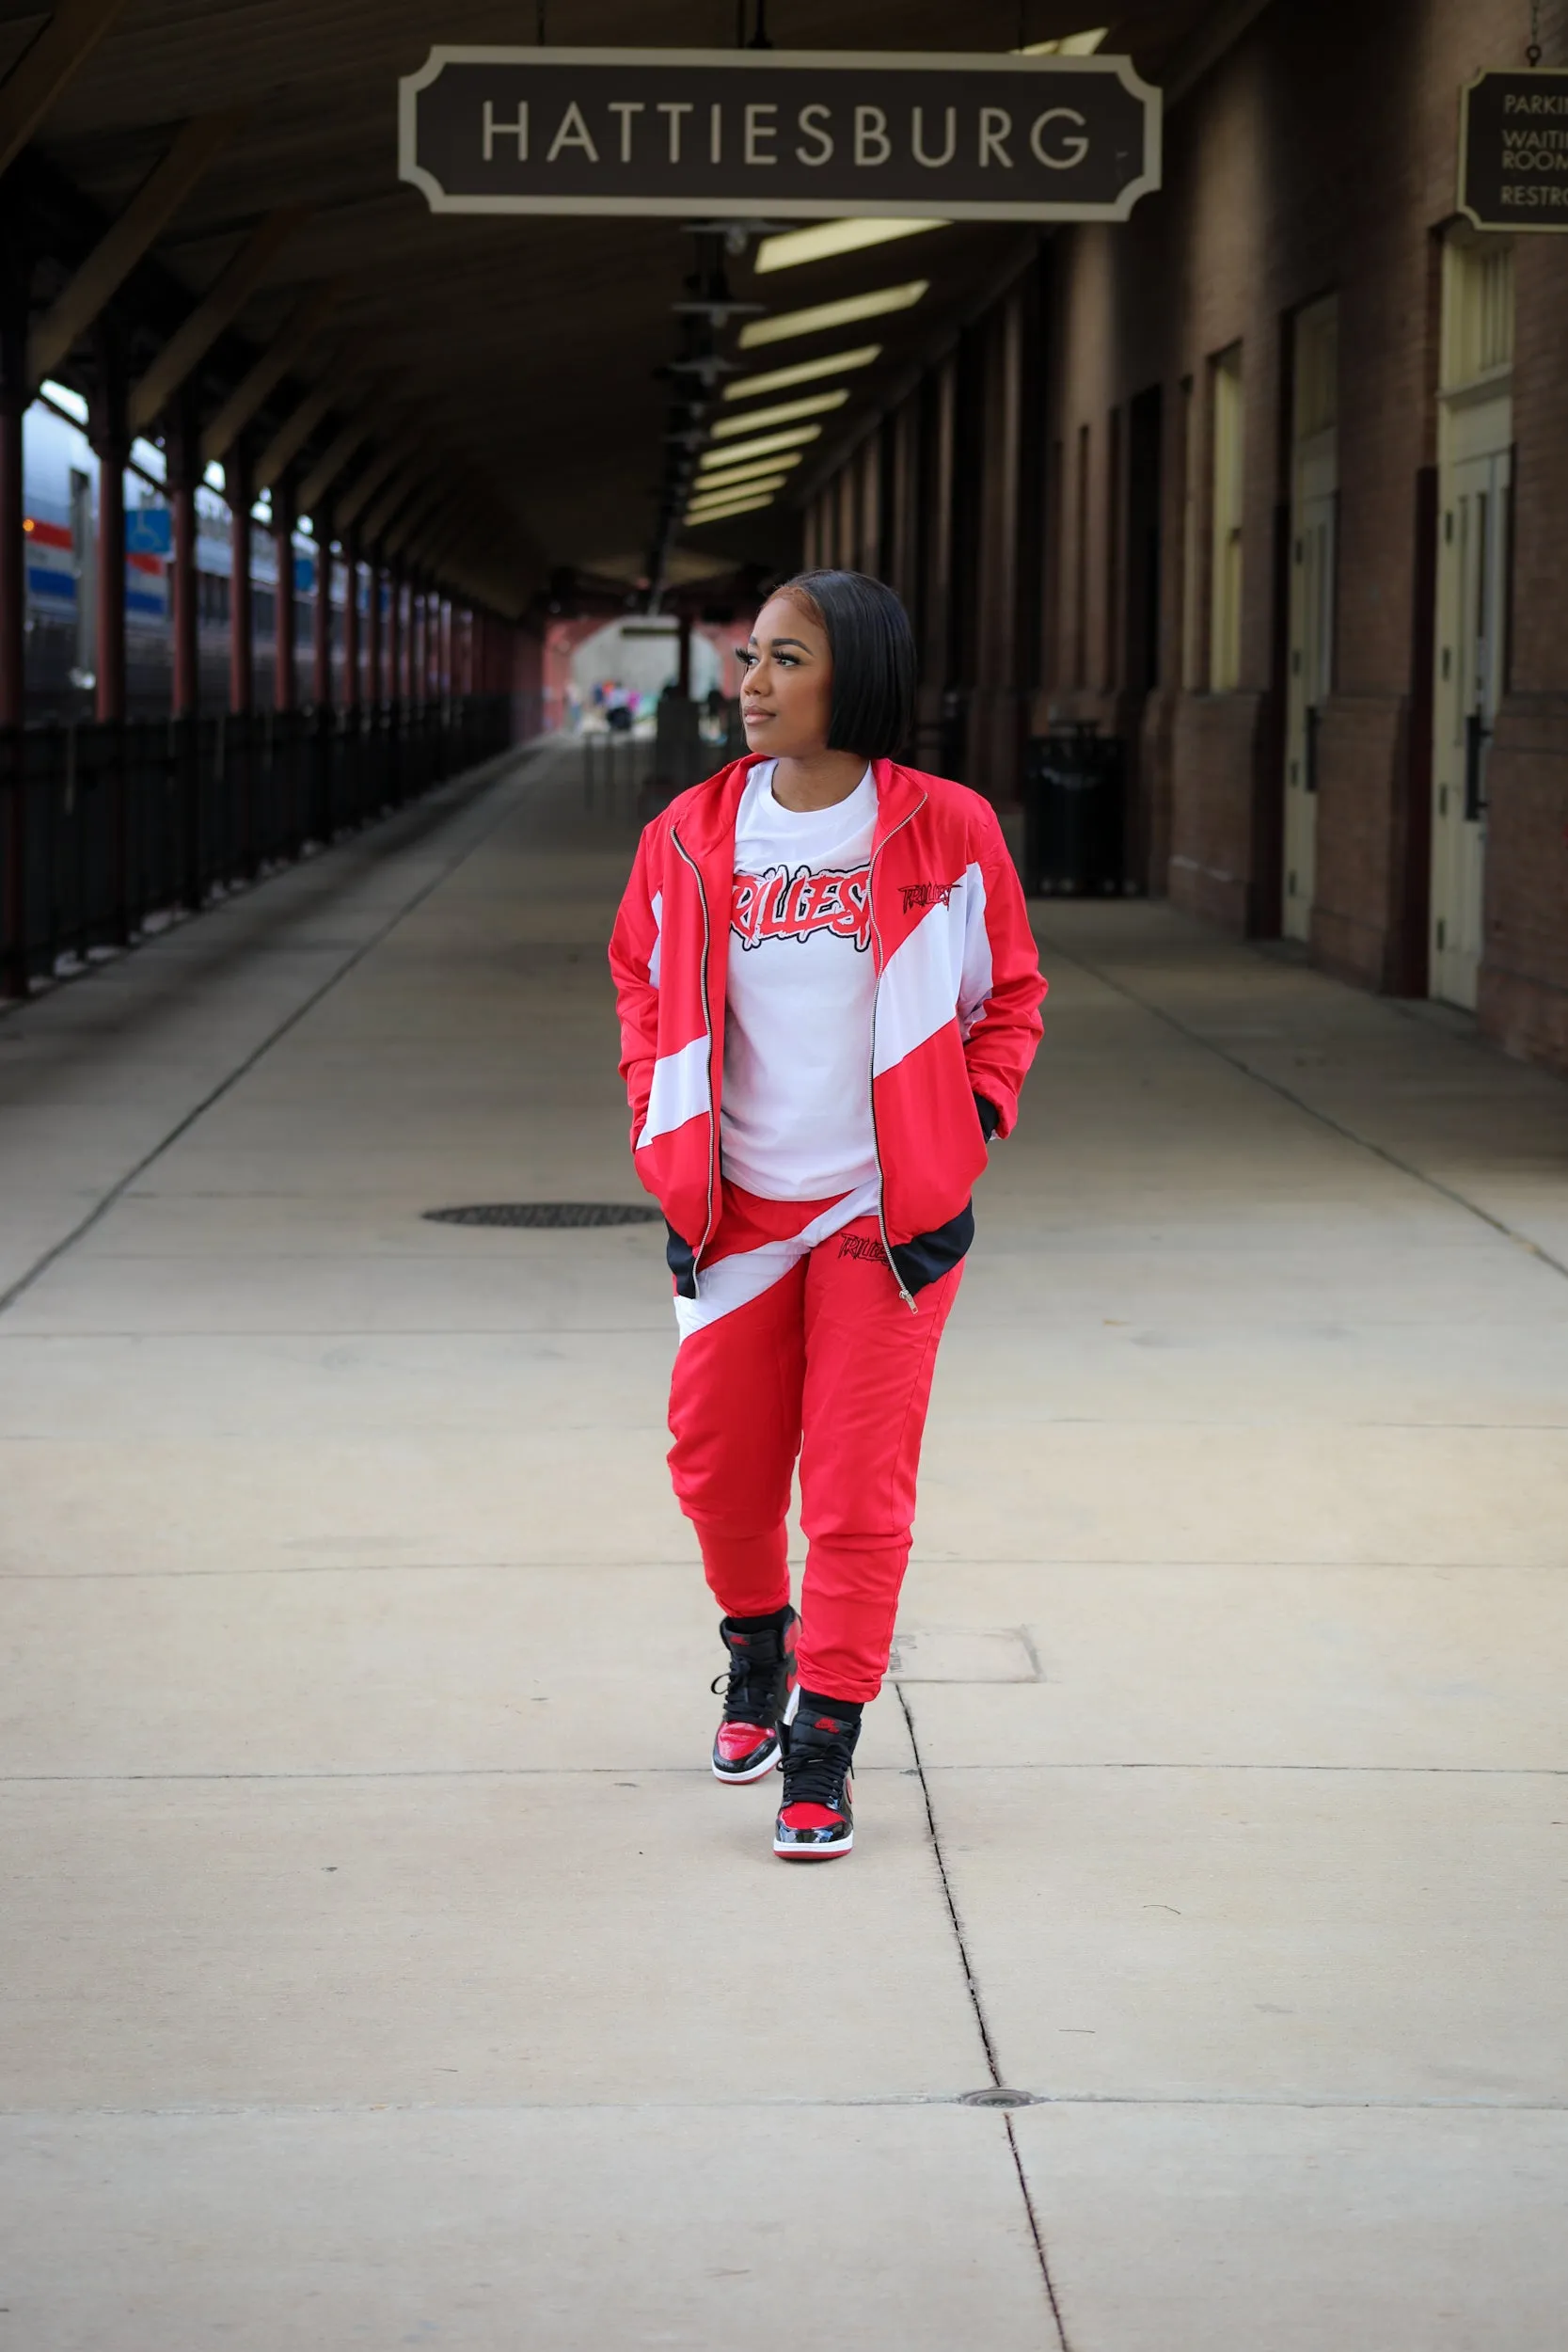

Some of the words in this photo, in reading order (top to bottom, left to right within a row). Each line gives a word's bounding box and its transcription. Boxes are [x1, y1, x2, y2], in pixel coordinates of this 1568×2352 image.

[1503, 93, 1568, 115] PARKI
[482, 100, 1091, 169] HATTIESBURG
[1500, 129, 1568, 151] WAITI
[1499, 184, 1568, 208] RESTR
